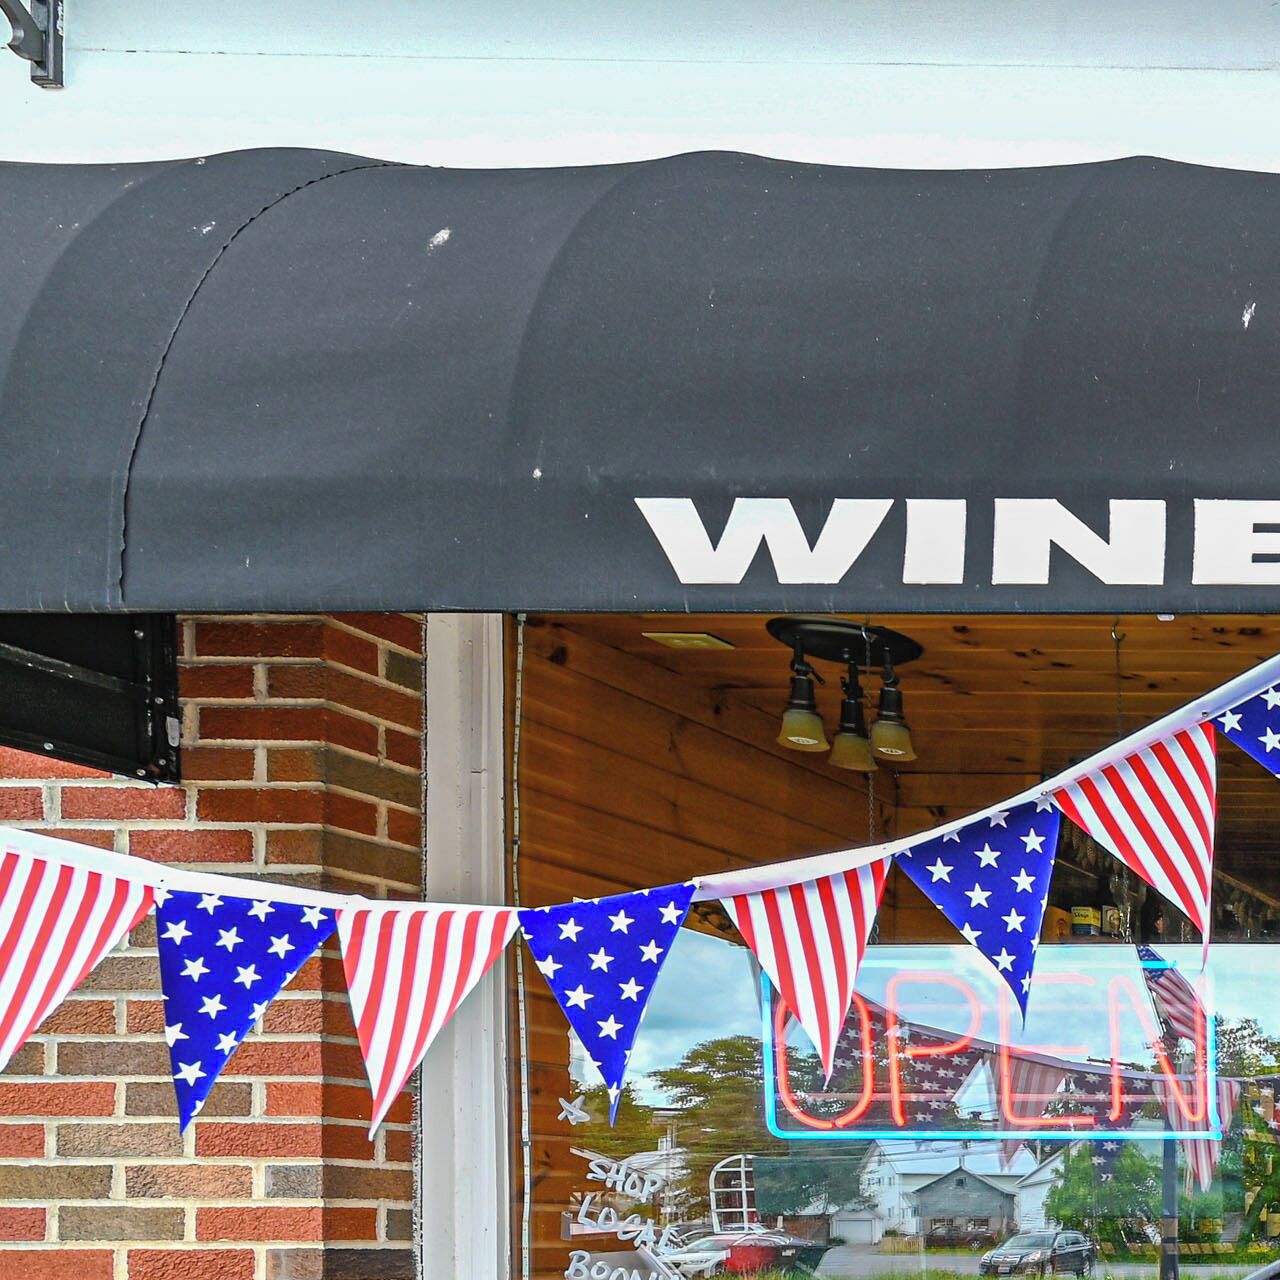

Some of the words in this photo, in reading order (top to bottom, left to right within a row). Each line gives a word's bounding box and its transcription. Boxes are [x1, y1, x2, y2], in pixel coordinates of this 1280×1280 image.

[774, 972, 1210, 1128] OPEN
[586, 1158, 668, 1203] SHOP
[577, 1194, 688, 1255] LOCAL
